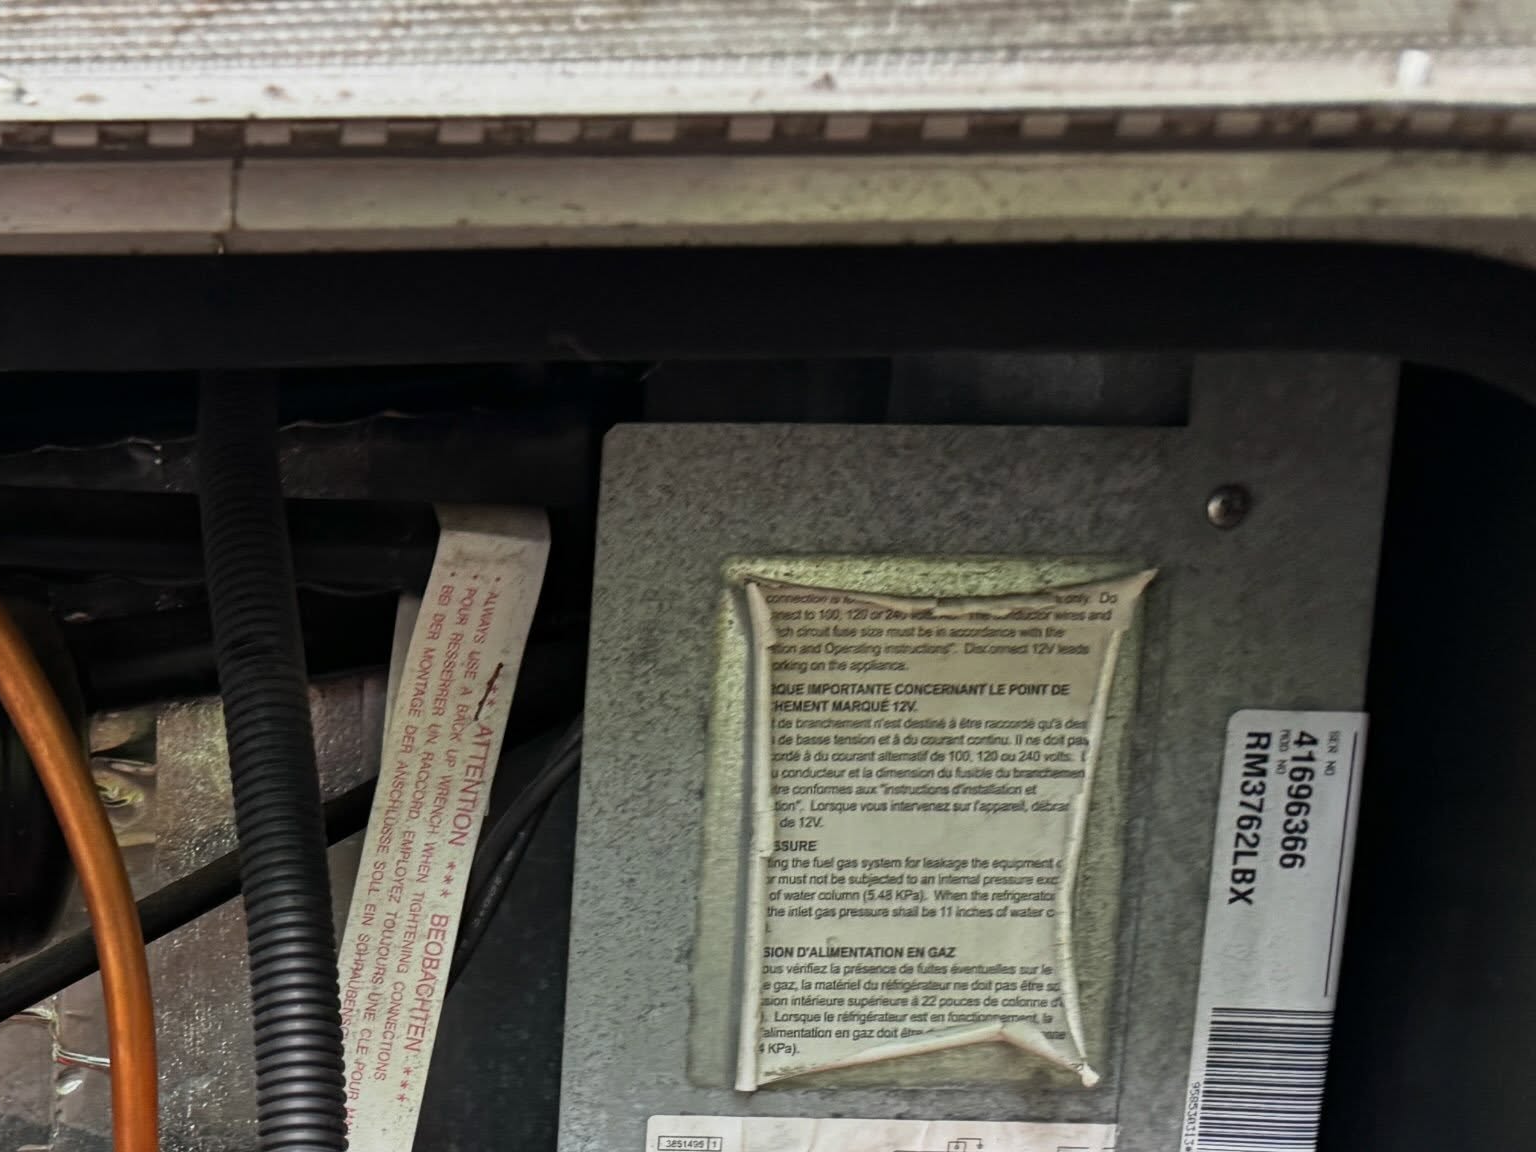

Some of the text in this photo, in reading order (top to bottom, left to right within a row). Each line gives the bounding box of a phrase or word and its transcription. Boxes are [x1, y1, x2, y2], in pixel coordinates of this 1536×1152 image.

[456, 587, 476, 626] POUR
[431, 632, 465, 717] RESSERRER
[808, 683, 1071, 696] IMPORTANTE CONCERNANT LE POINT DE
[832, 698, 891, 712] MARQUÉ
[796, 718, 872, 728] branchement
[424, 723, 441, 745] UN
[796, 735, 831, 745] basse
[834, 735, 874, 745] tension
[920, 735, 965, 745] courant
[360, 584, 453, 926] BEI DER MONTAGE DER SOLL EIN
[782, 768, 934, 778] conducteur dimension
[1277, 729, 1319, 871] 41696366
[810, 801, 887, 814] Lorsque vous
[779, 817, 795, 827] de
[1226, 729, 1272, 907] RM3762LBX
[372, 591, 498, 1081] ALWAYS USE A BACK UP WRENCH WHEN TIGHTENING CONNECTIONS
[388, 829, 416, 903] EMPLOYEZ
[792, 857, 989, 871] the fuel gas system for leakage the
[402, 723, 494, 1052] ATTENTION BEOBACHTEN
[778, 874, 904, 887] must not be subjected
[769, 890, 782, 900] of
[784, 891, 816, 901] water
[818, 890, 860, 901] column
[934, 890, 968, 901] When
[767, 906, 889, 920] the inlet gas pressure
[370, 910, 397, 985] TOUJOURS
[797, 946, 904, 958] D'ALIMENTATION
[907, 947, 925, 958] EN
[928, 947, 956, 958] GAZ
[843, 964, 897, 976] présence
[815, 979, 861, 990] matériel
[363, 991, 379, 1020] UNE
[346, 1061, 364, 1100] POUR
